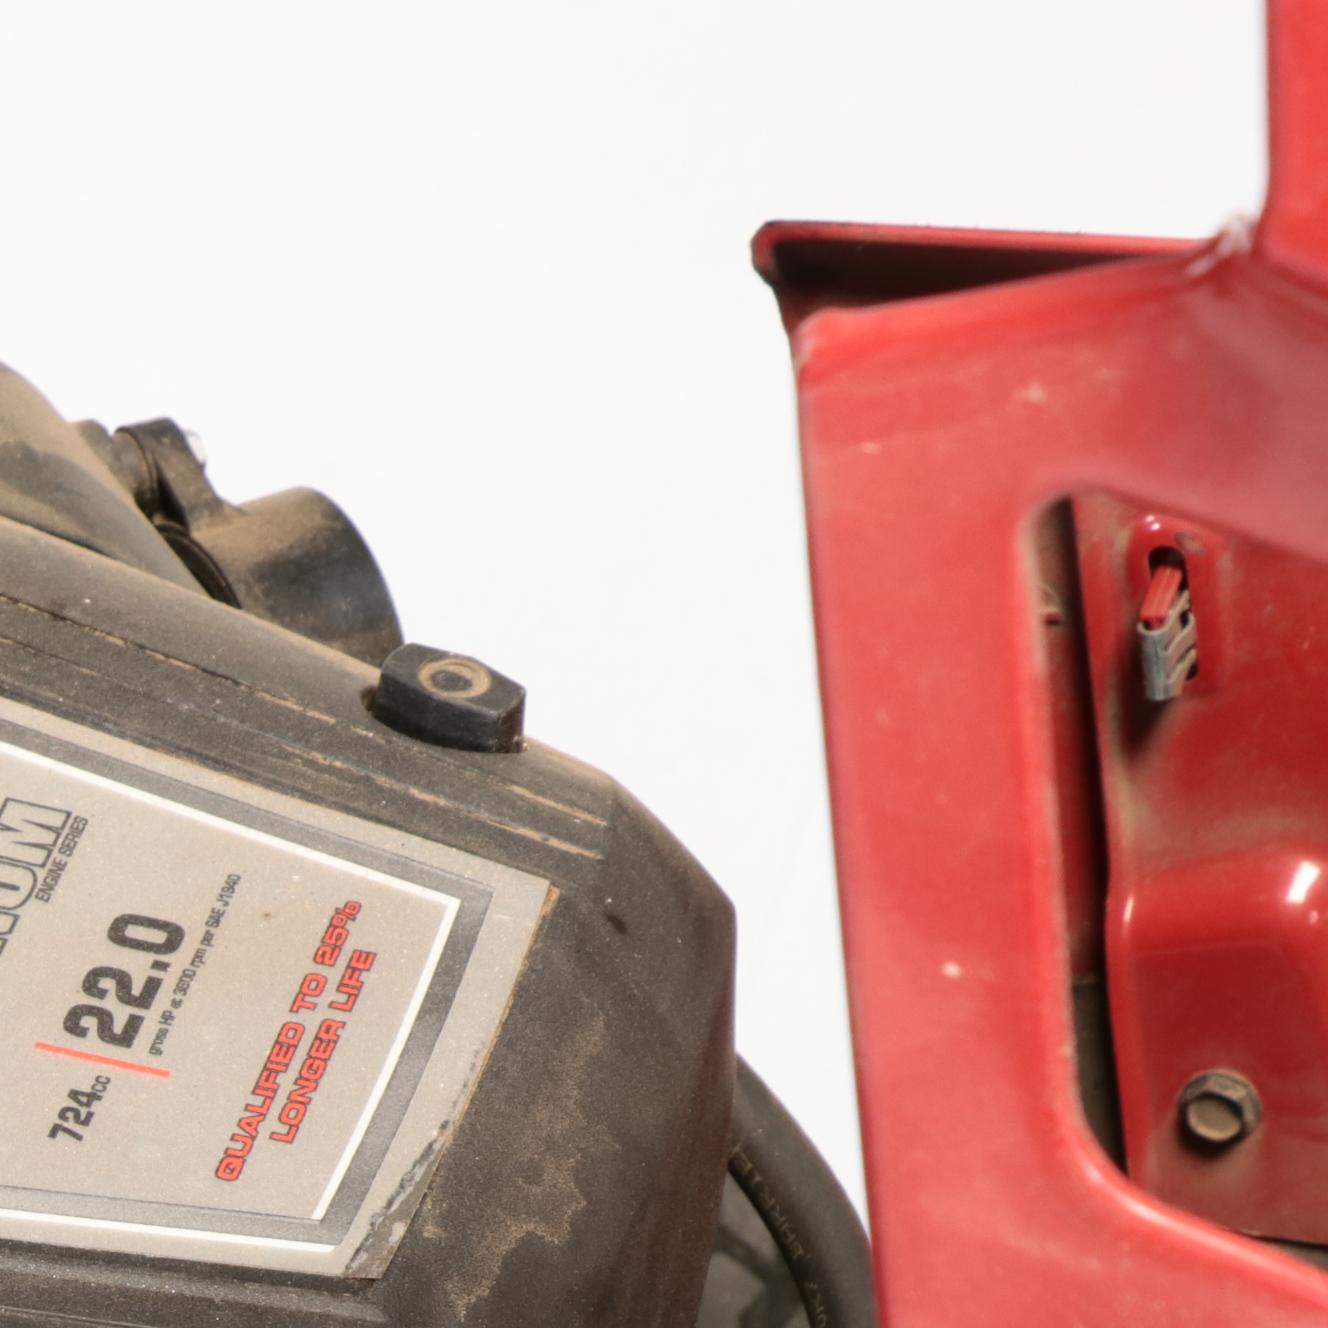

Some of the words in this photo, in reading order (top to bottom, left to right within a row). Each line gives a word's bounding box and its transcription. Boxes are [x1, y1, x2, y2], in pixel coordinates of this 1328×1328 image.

[34, 857, 68, 903] ENGINE
[57, 815, 88, 858] SERIES
[216, 873, 242, 908] J1940
[204, 907, 226, 929] SAE
[199, 929, 216, 948] per
[189, 947, 206, 969] rpm
[62, 913, 186, 1049] 22.0
[173, 967, 196, 997] 3600
[158, 1009, 176, 1027] HP
[148, 1027, 169, 1057] gross
[214, 1020, 306, 1182] QUALIFIED
[289, 972, 328, 1014] TO
[313, 899, 363, 968] 25%
[269, 1017, 347, 1145] LONGER
[328, 948, 378, 1013] LIFE
